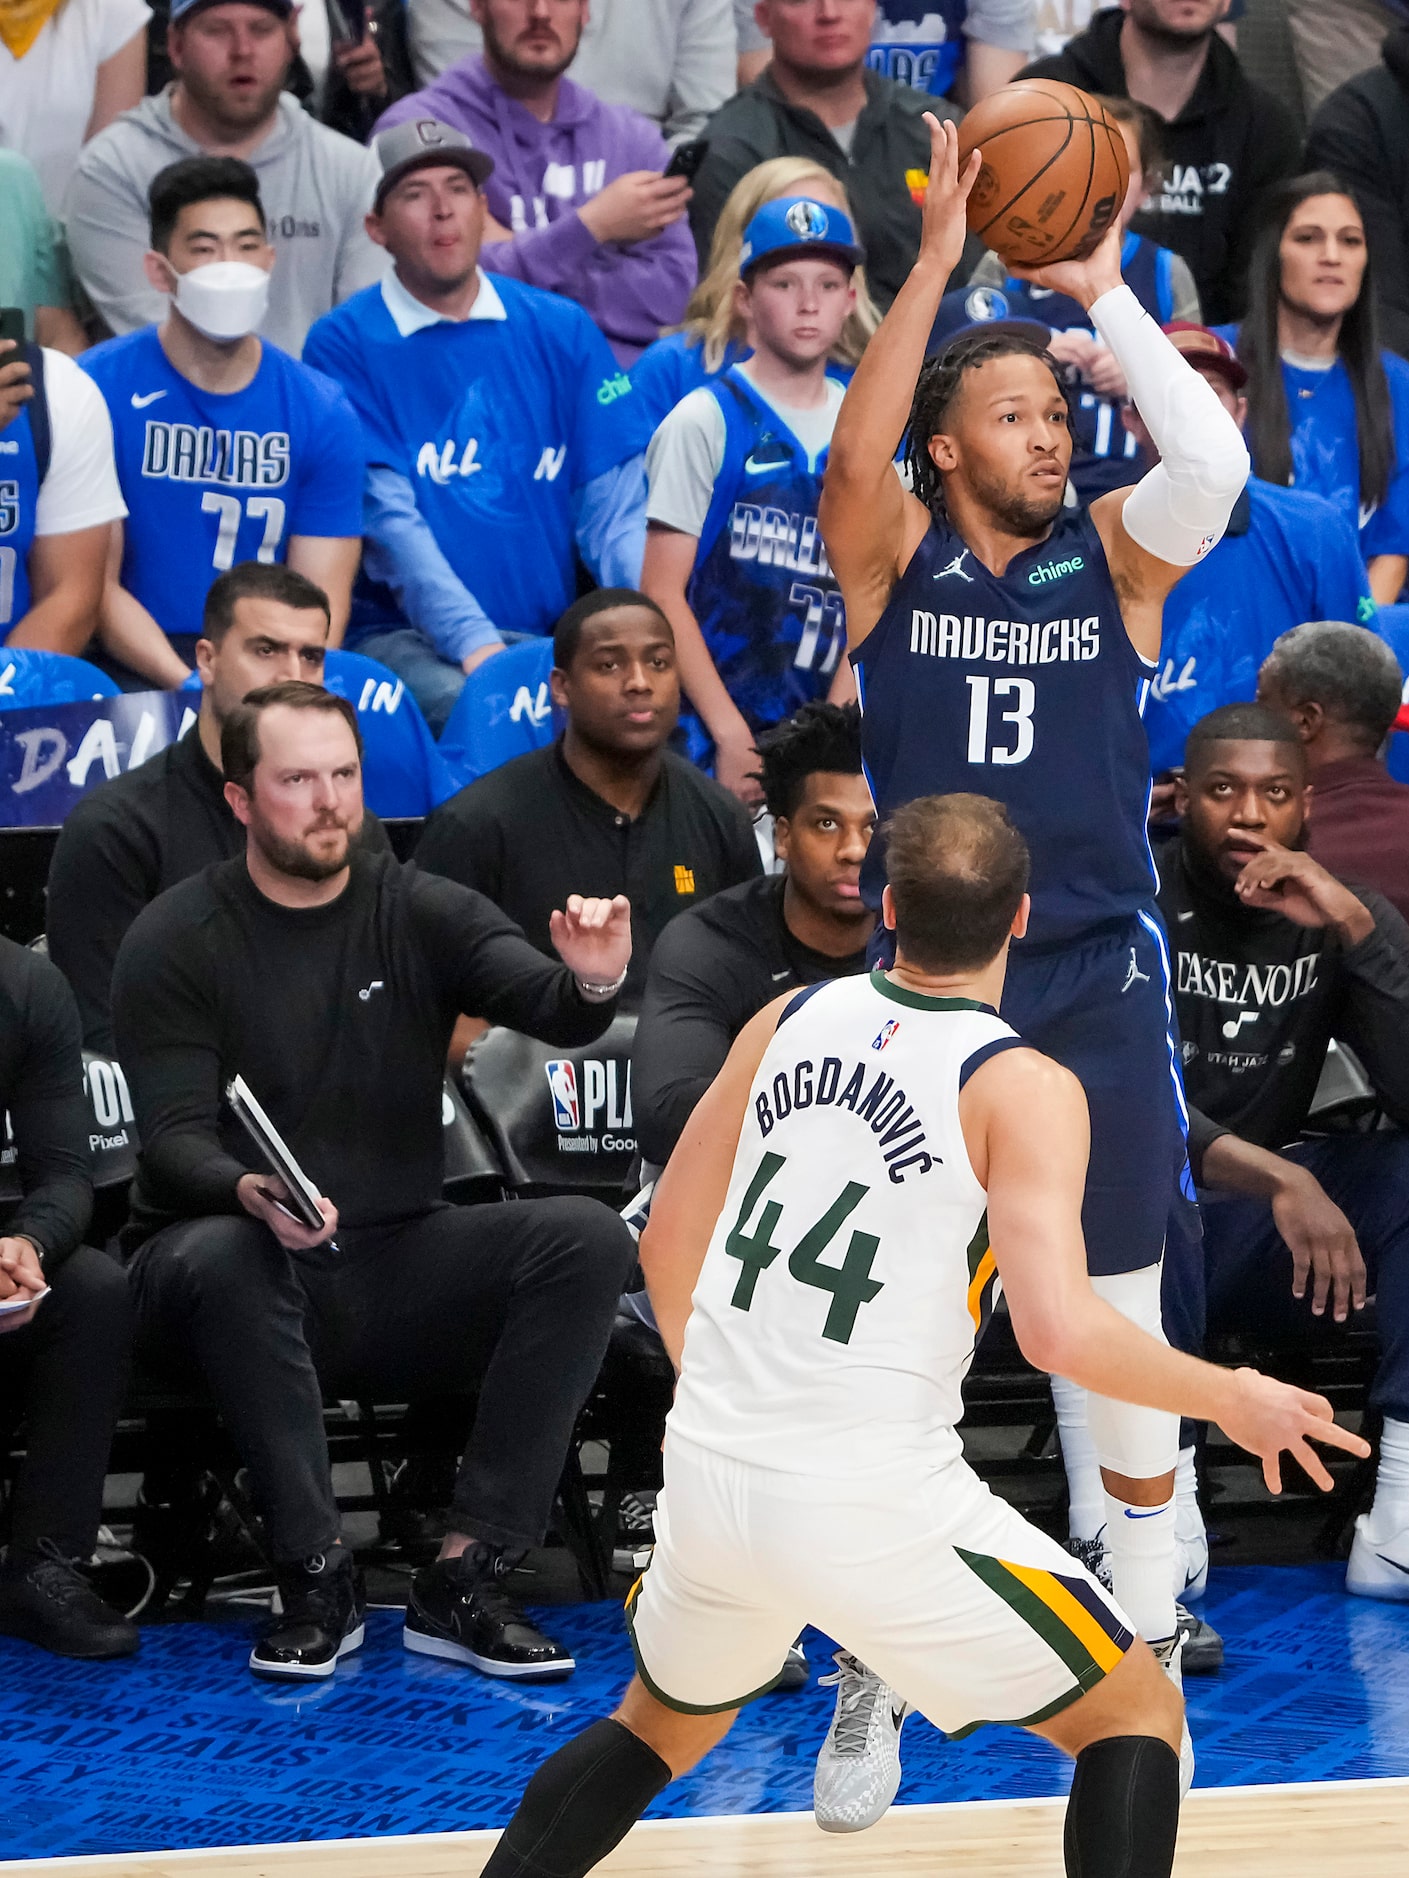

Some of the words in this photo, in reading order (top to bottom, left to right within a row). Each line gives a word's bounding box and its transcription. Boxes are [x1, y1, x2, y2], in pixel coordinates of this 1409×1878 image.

[141, 419, 291, 489] DALLAS
[416, 438, 482, 485] ALL
[200, 491, 286, 571] 77
[1028, 555, 1085, 587] chime
[909, 608, 1100, 666] MAVERICKS
[358, 678, 404, 714] IN
[965, 675, 1036, 765] 13
[754, 1056, 944, 1185] BOGDANOVIĆ
[88, 1128, 130, 1152] Pixel
[724, 1150, 886, 1346] 44
[6, 1697, 171, 1725] JERRY
[165, 1711, 500, 1755] STACKHOUSE
[312, 1692, 496, 1725] DIRK
[119, 1731, 331, 1767] DAVIS
[148, 1758, 288, 1778] JACKSON
[95, 1790, 193, 1807] MACK
[265, 1776, 422, 1804] JOSH
[80, 1808, 329, 1841] HARRISON
[203, 1799, 411, 1830] DORIAN
